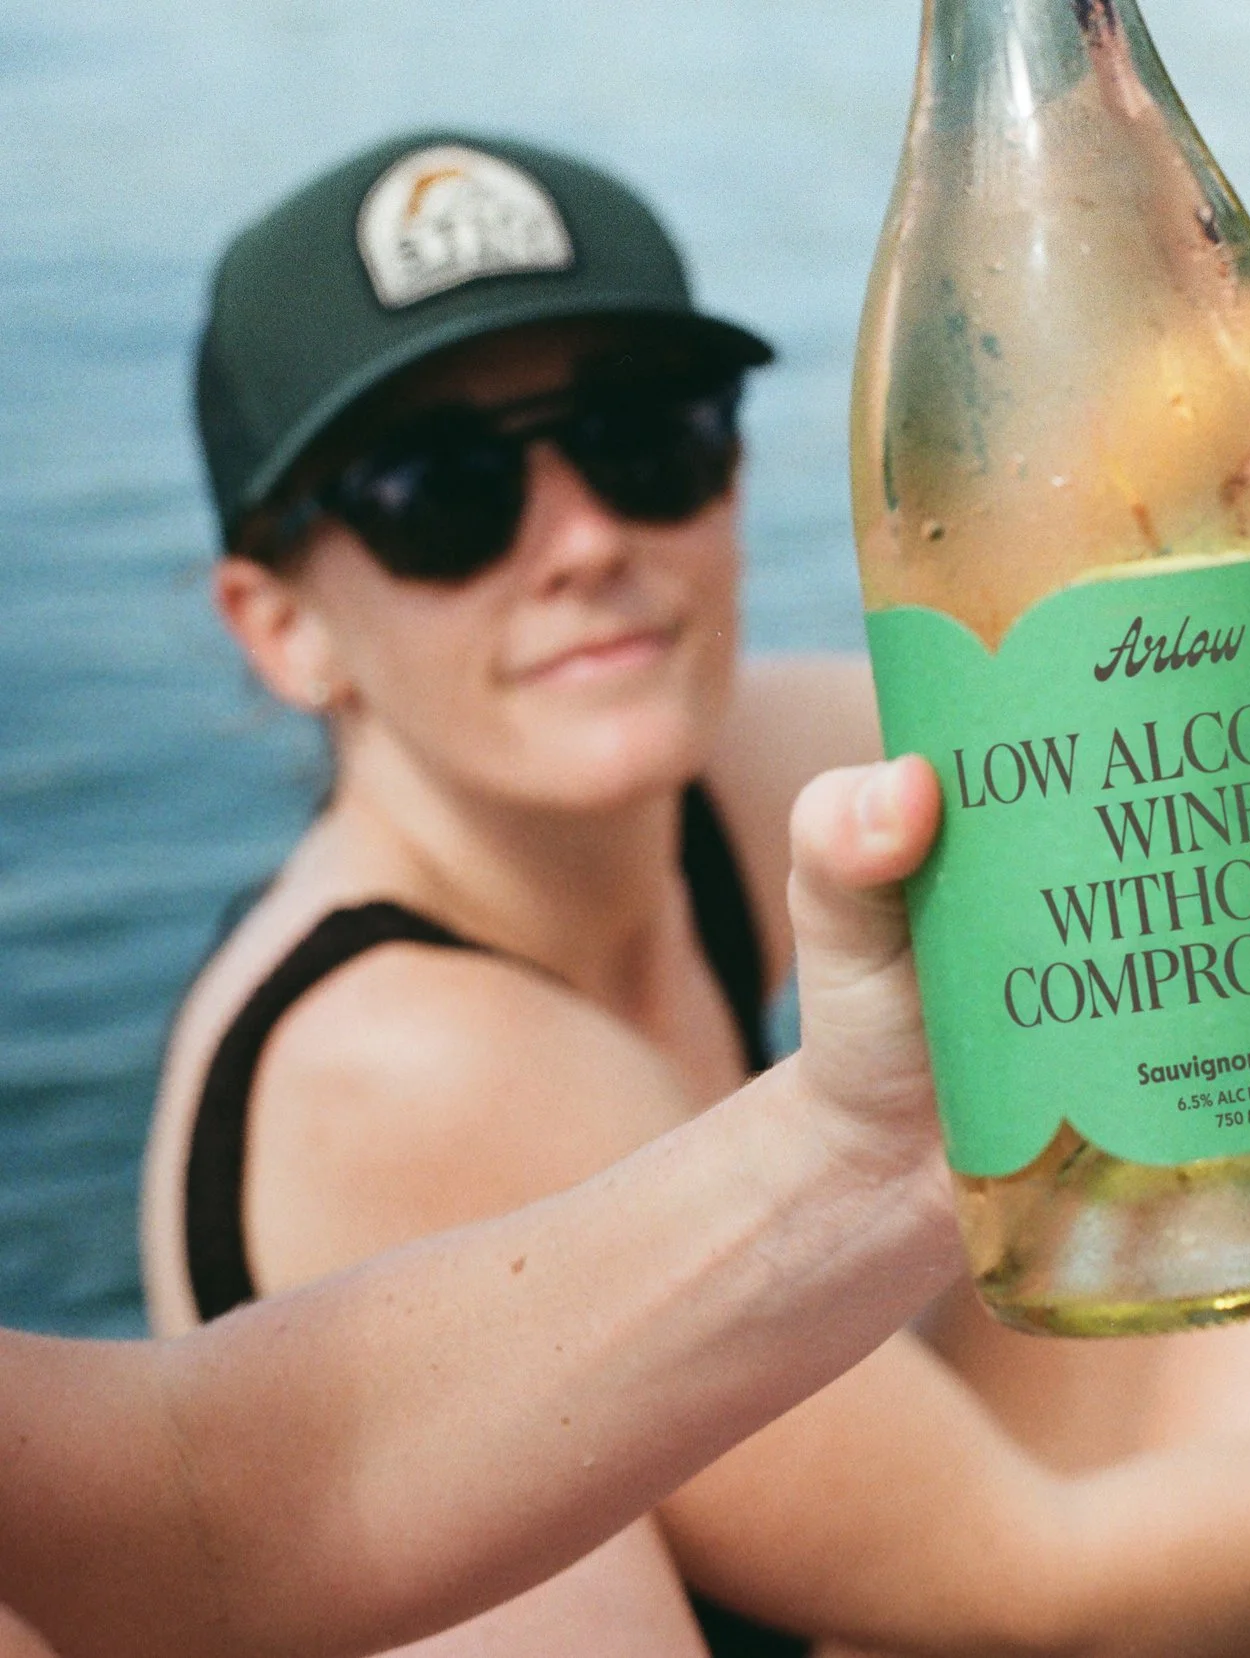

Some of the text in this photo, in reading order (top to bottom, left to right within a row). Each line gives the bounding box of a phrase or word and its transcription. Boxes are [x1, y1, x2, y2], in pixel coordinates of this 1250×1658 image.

[1094, 616, 1246, 682] Arlow
[953, 734, 1079, 809] LOW
[1177, 1093, 1213, 1111] 6.5%
[1217, 1087, 1246, 1105] ALC
[1215, 1111, 1244, 1128] 750
